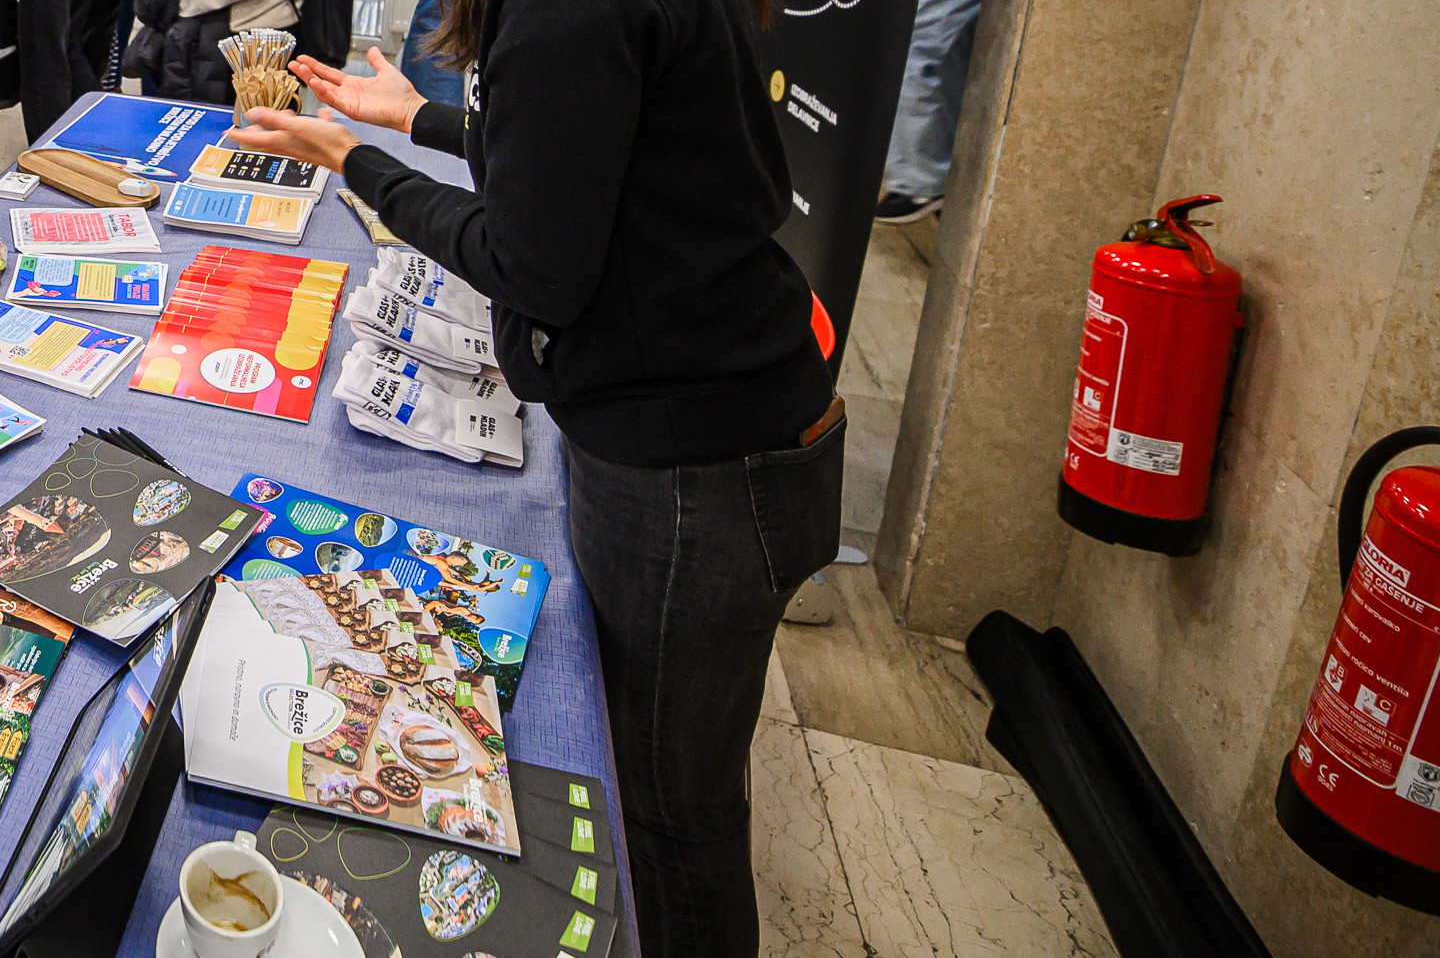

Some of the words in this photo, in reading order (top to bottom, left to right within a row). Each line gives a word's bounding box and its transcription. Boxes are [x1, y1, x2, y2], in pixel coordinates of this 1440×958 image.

[118, 213, 137, 237] TABOR
[70, 558, 119, 595] Brežice
[1364, 566, 1374, 582] ZA
[1375, 670, 1410, 698] ventila
[291, 689, 309, 735] Brežice
[1379, 699, 1392, 711] C
